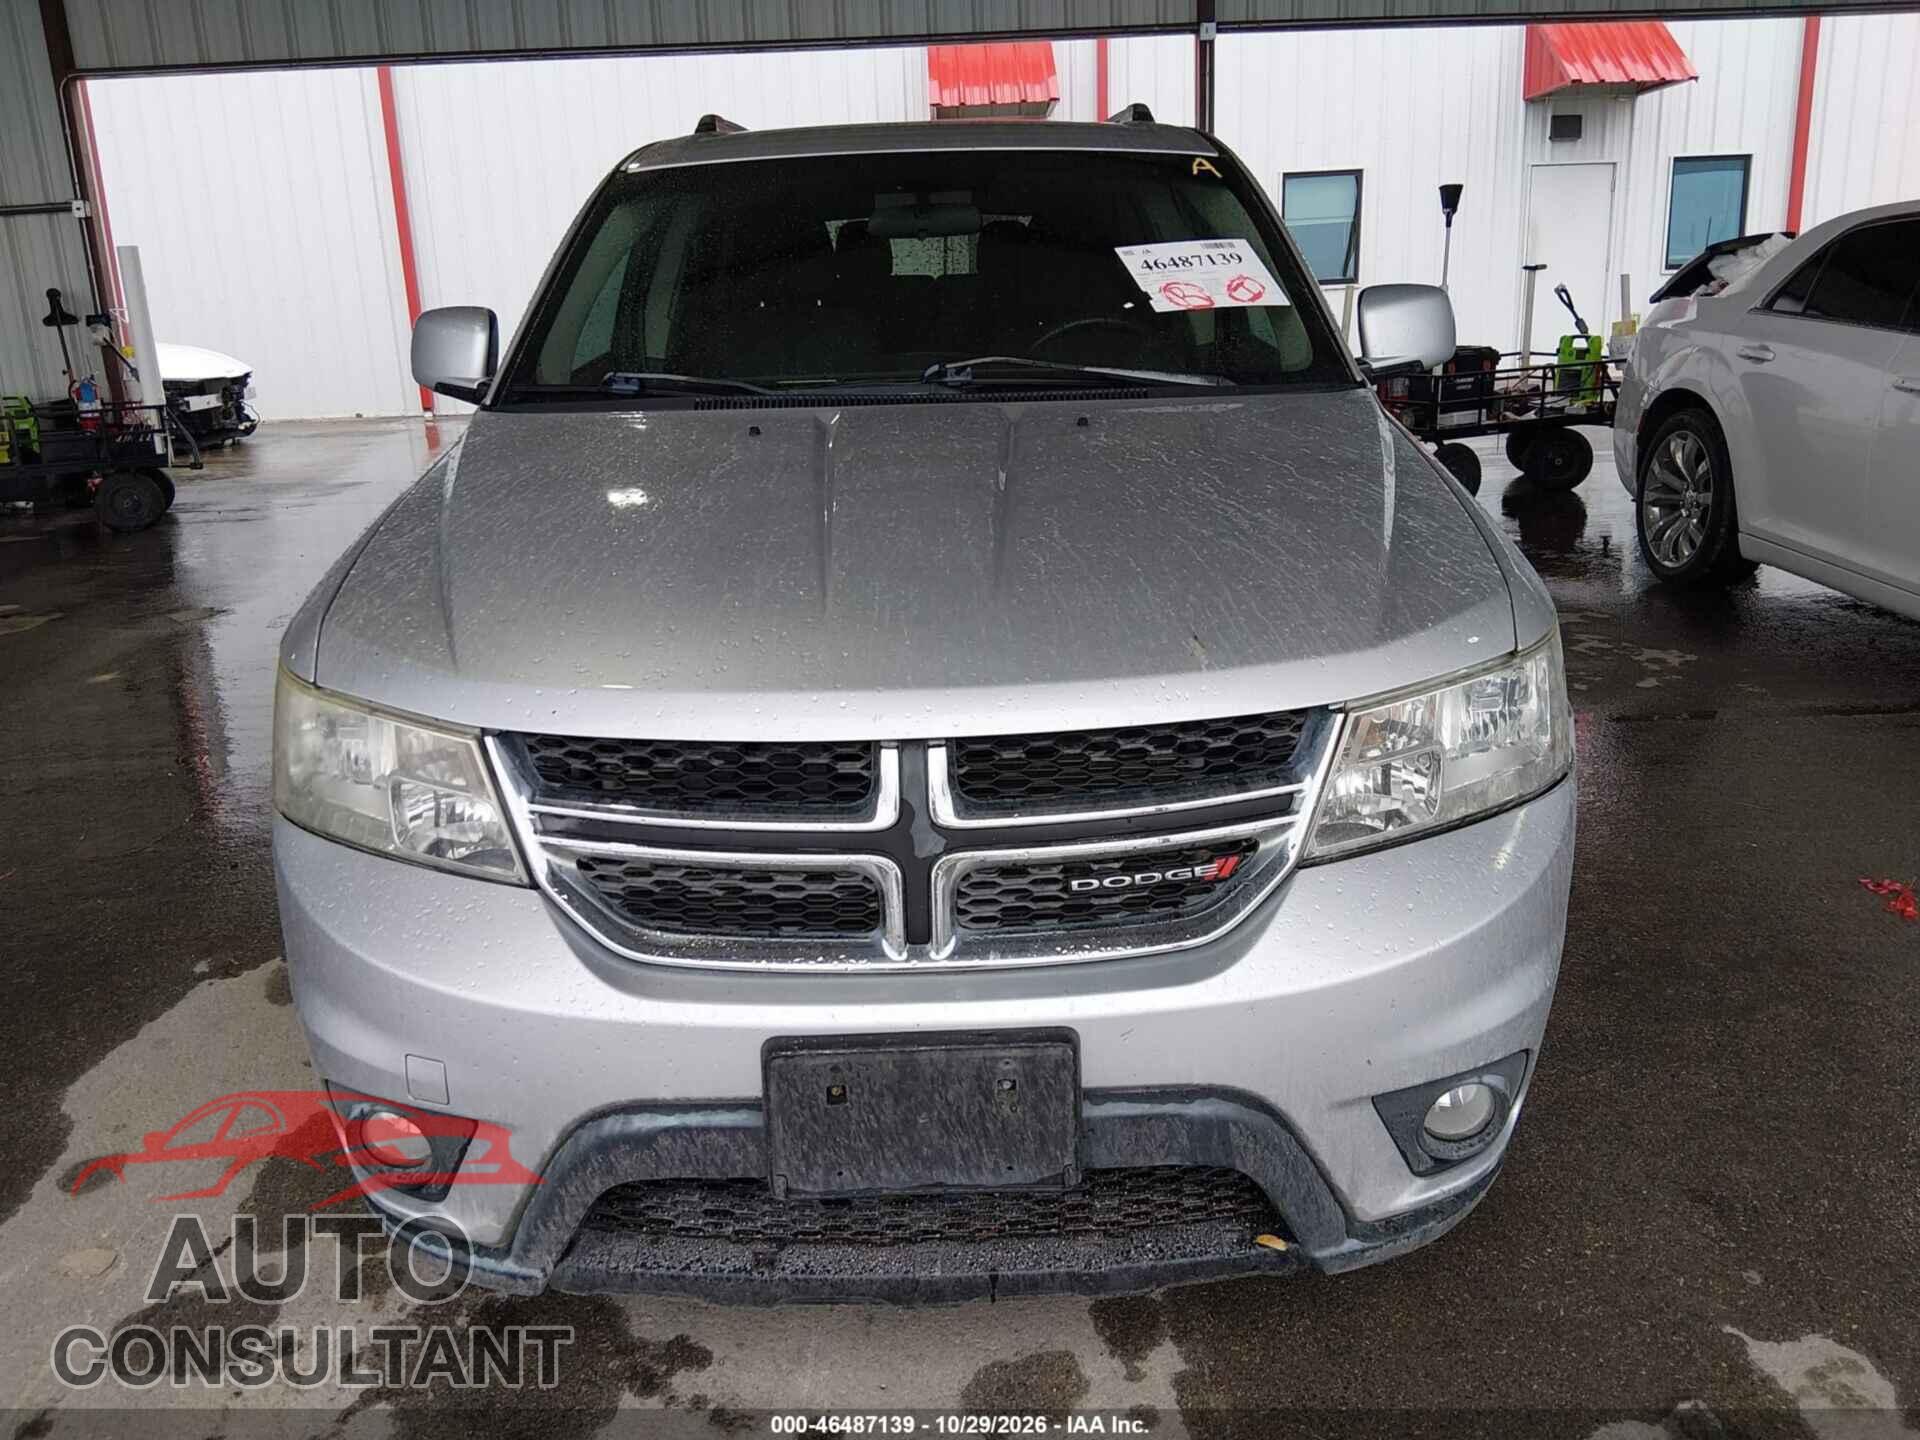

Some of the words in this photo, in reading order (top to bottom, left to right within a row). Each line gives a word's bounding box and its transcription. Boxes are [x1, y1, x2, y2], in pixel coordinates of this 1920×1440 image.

[1192, 157, 1222, 178] A
[1140, 252, 1243, 271] 46487139
[1071, 863, 1218, 891] DODGE
